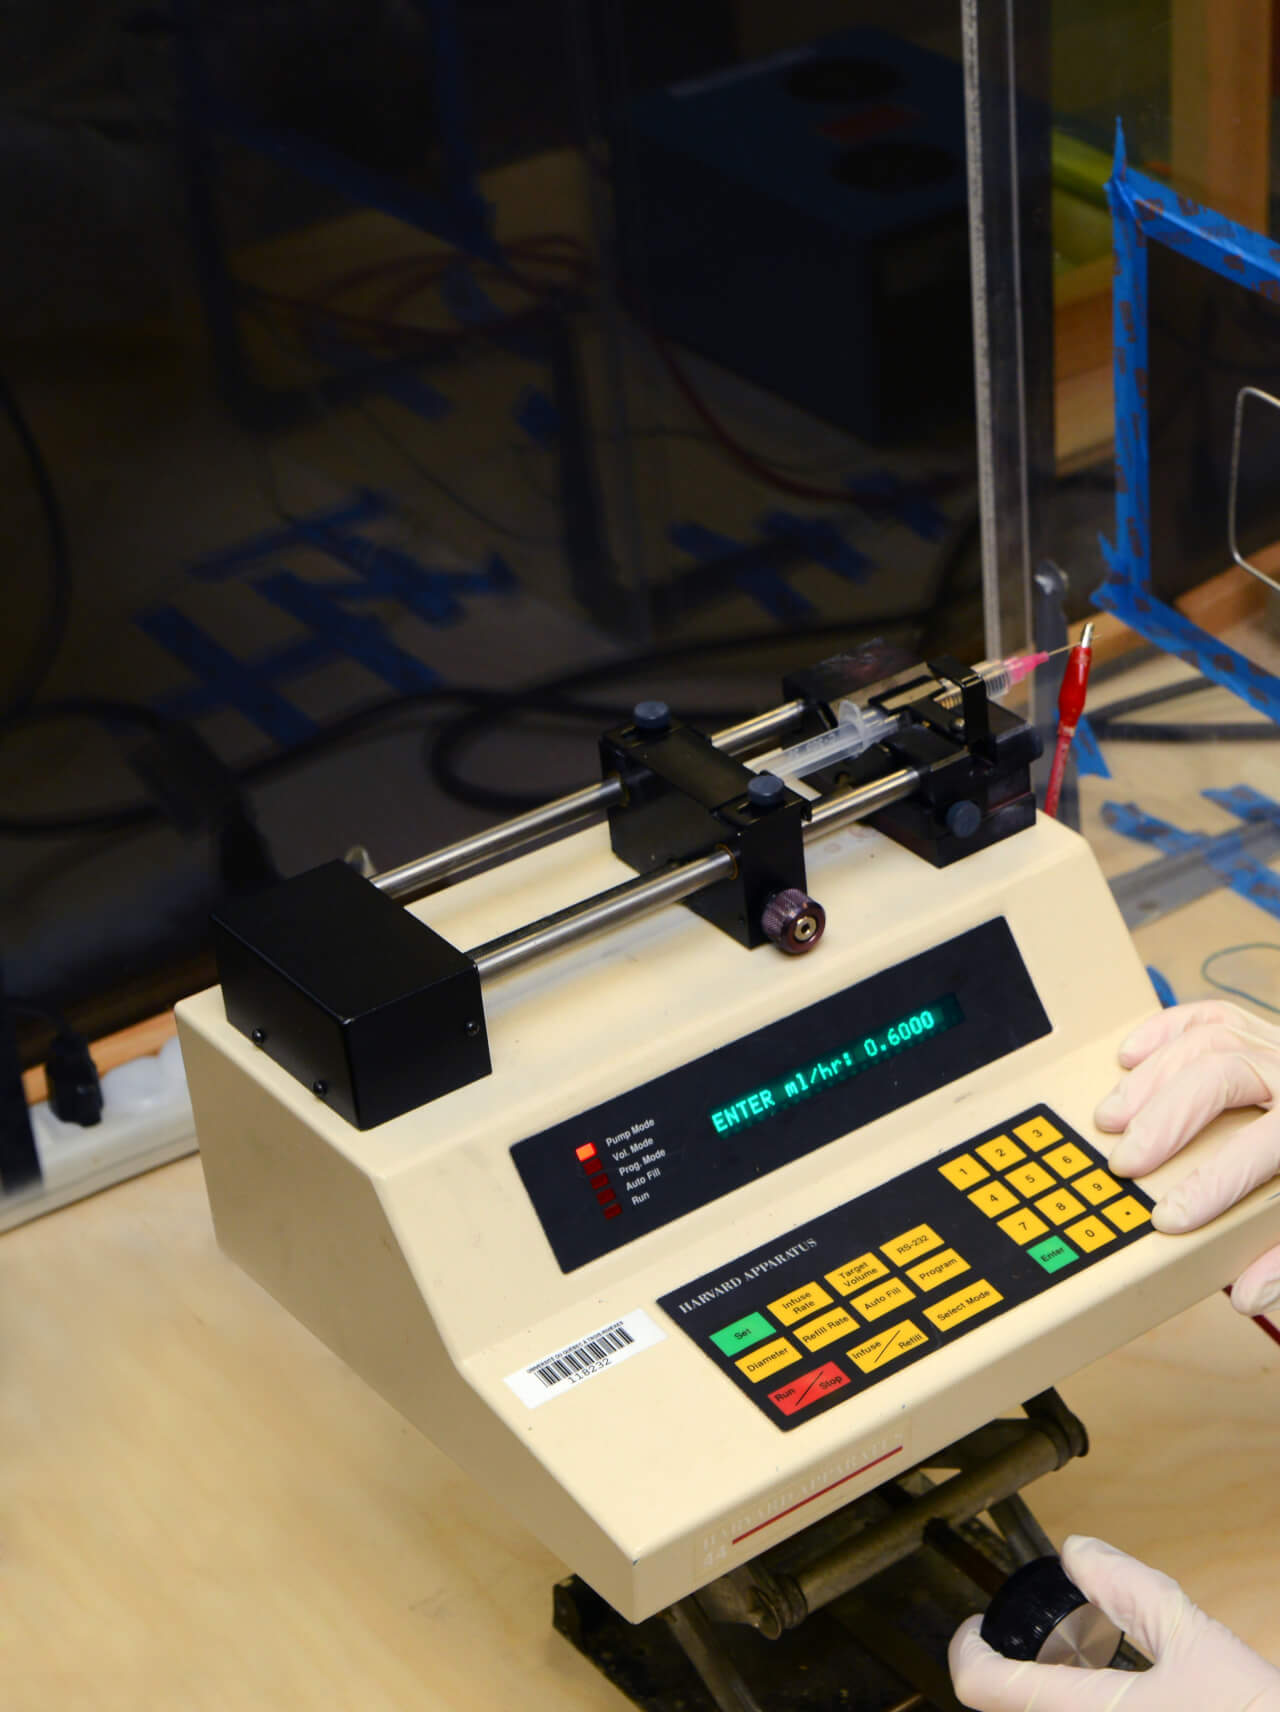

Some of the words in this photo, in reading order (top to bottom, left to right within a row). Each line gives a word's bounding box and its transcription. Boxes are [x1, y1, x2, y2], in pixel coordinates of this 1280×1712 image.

[711, 1089, 776, 1133] ENTER
[784, 1051, 853, 1099] ml/hr:
[863, 1010, 935, 1057] 0.6000
[606, 1130, 632, 1147] Pump
[631, 1118, 655, 1138] Mode
[1032, 1128, 1043, 1138] 3
[612, 1148, 631, 1162] Vol.
[631, 1136, 654, 1154] Mode
[995, 1148, 1006, 1157] 2
[619, 1161, 643, 1178] Prog.
[642, 1148, 666, 1166] Mode
[1062, 1155, 1072, 1164] 6
[626, 1176, 645, 1192] Auto
[645, 1168, 661, 1184] Fill
[959, 1167, 968, 1176] 1
[1025, 1174, 1035, 1184] 5
[1092, 1183, 1103, 1192] 9
[632, 1191, 650, 1206] Run
[989, 1194, 999, 1203] 4
[1056, 1202, 1066, 1211] 8
[1018, 1222, 1028, 1231] 7
[1085, 1229, 1095, 1238] 0
[896, 1234, 929, 1254] RS-232
[1040, 1247, 1065, 1263] Enter
[678, 1276, 743, 1314] HARVARD
[743, 1238, 818, 1281] APPARATUS
[839, 1261, 868, 1280] Target
[843, 1267, 878, 1287] Volume
[919, 1257, 958, 1280] Program
[783, 1291, 811, 1309] Infuse
[793, 1300, 815, 1315] Rate
[864, 1294, 886, 1311] Auto
[886, 1286, 902, 1298] Fill
[937, 1303, 967, 1321] Select
[966, 1290, 991, 1304] Mode
[734, 1328, 752, 1340] Set
[802, 1326, 827, 1343] Refill
[827, 1315, 849, 1330] Rate
[852, 1340, 882, 1360] Infuse
[898, 1333, 923, 1350] Refill
[747, 1347, 788, 1372] Diameter
[567, 1358, 611, 1384] 118232
[774, 1387, 796, 1402] Run
[819, 1375, 843, 1390] Stop
